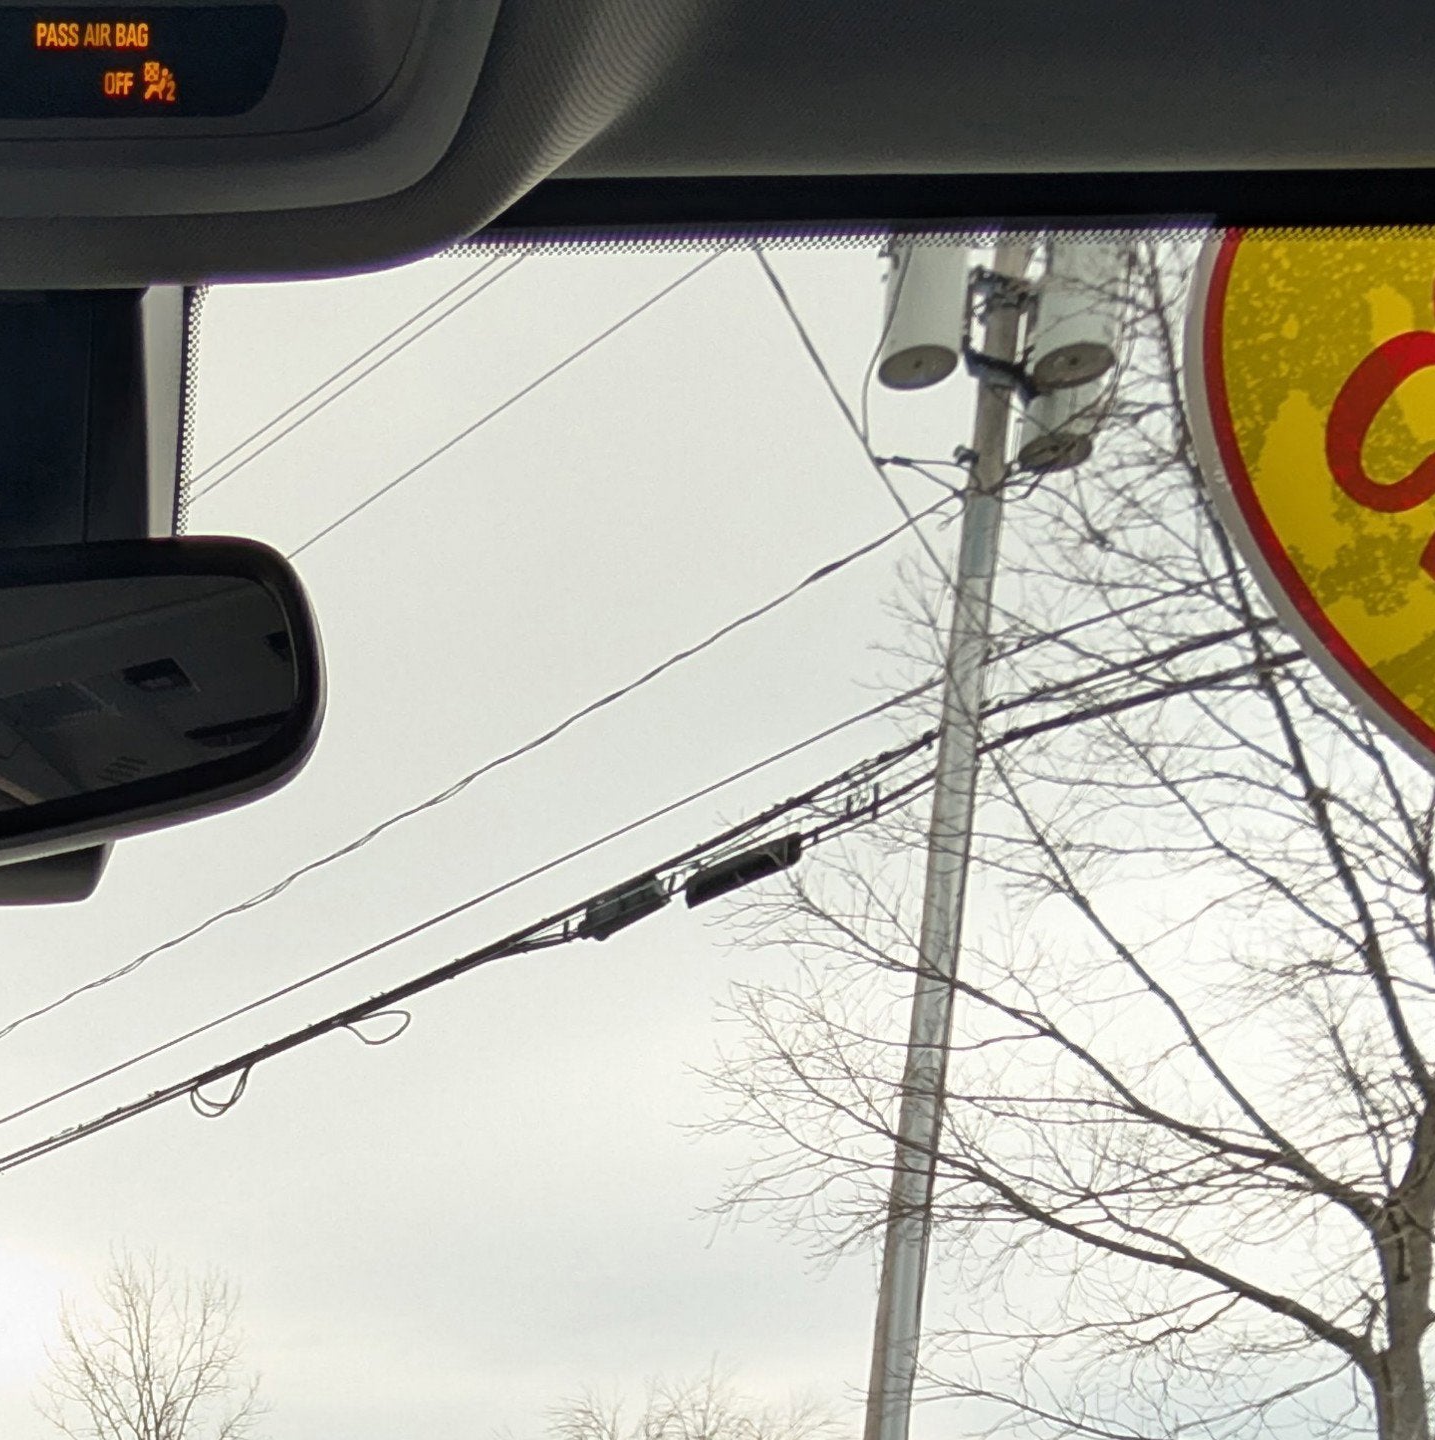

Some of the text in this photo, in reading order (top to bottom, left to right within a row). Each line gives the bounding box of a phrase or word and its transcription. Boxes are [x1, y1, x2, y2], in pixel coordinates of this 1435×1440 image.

[35, 22, 149, 48] PASS AIR BAG
[103, 72, 134, 96] OFF
